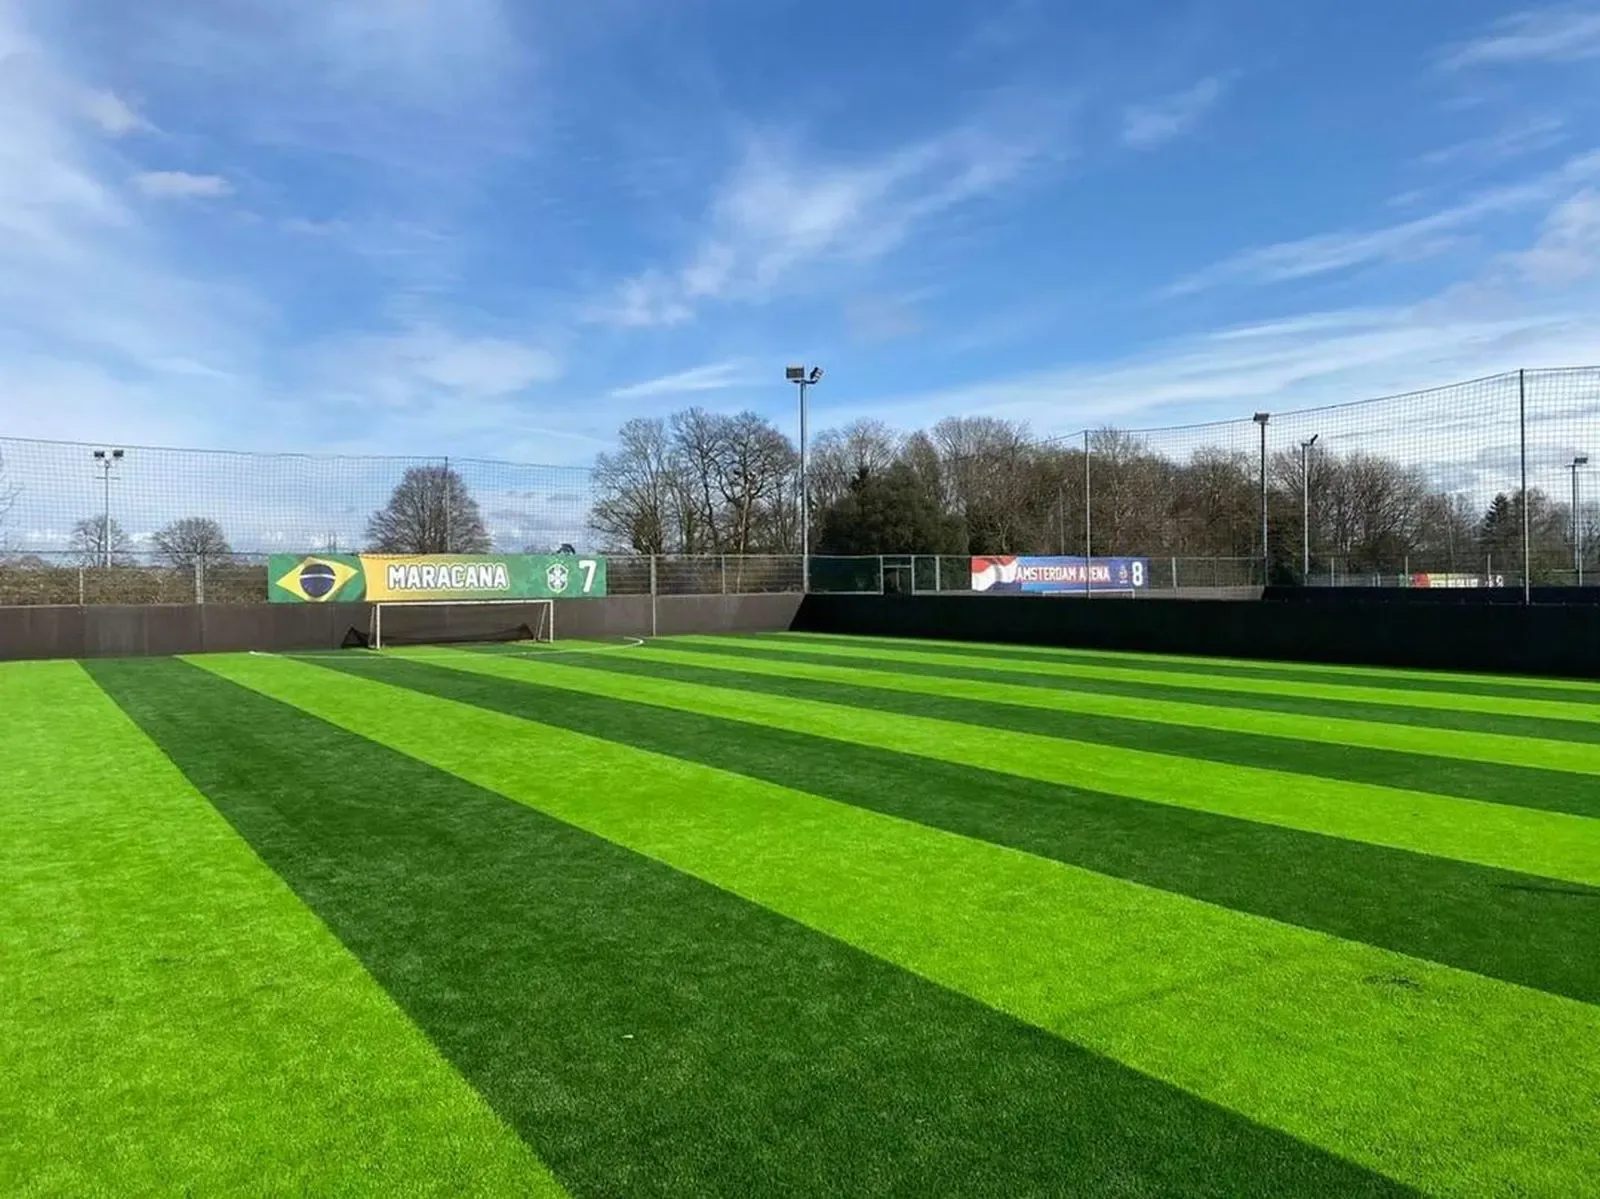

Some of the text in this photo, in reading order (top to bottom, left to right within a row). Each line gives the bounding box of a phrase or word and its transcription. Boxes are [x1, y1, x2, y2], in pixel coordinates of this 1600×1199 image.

[387, 564, 509, 590] MARACANA
[578, 560, 597, 592] 7
[1015, 566, 1110, 581] AMSTERDAM AENA
[1132, 561, 1143, 586] 8
